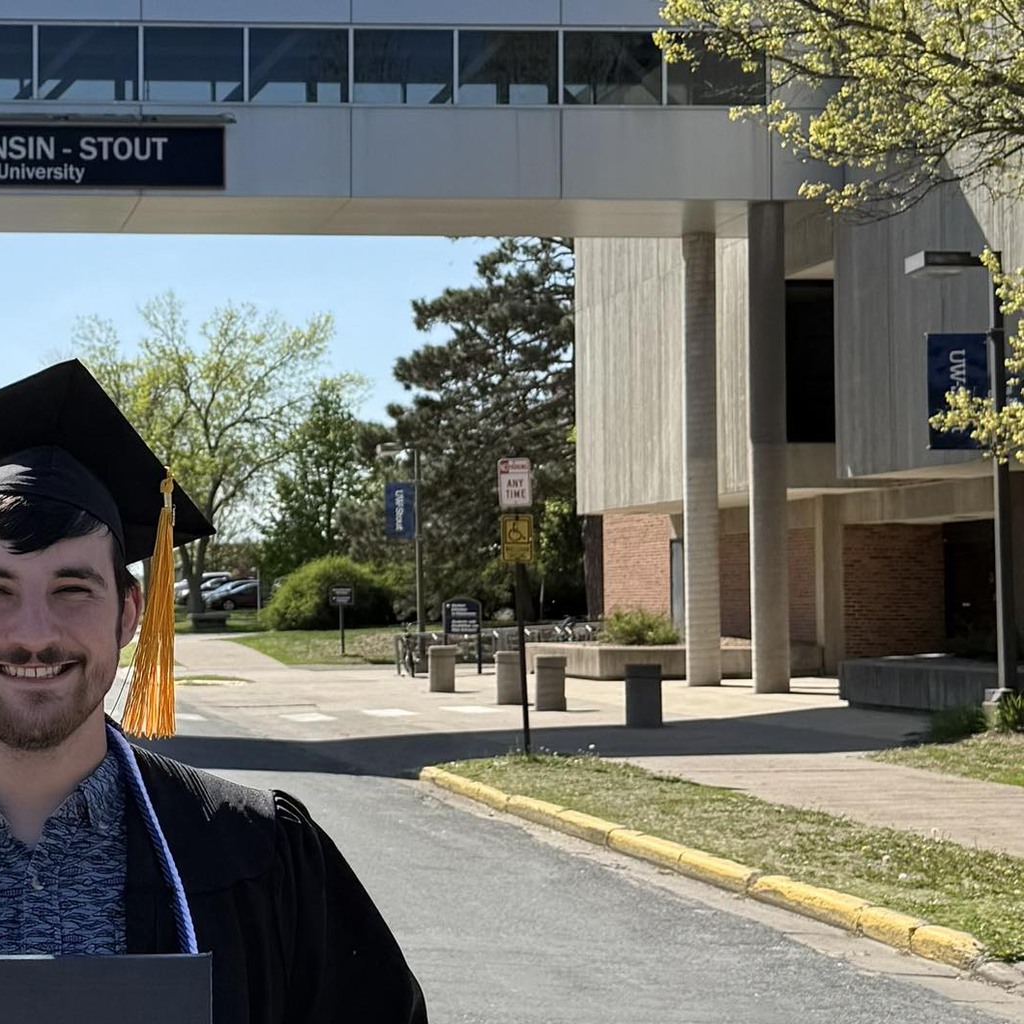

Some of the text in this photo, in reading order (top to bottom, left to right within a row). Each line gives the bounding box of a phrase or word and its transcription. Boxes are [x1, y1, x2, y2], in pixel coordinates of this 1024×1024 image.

[79, 136, 168, 161] STOUT
[506, 479, 524, 488] ANY
[505, 489, 526, 499] TIME
